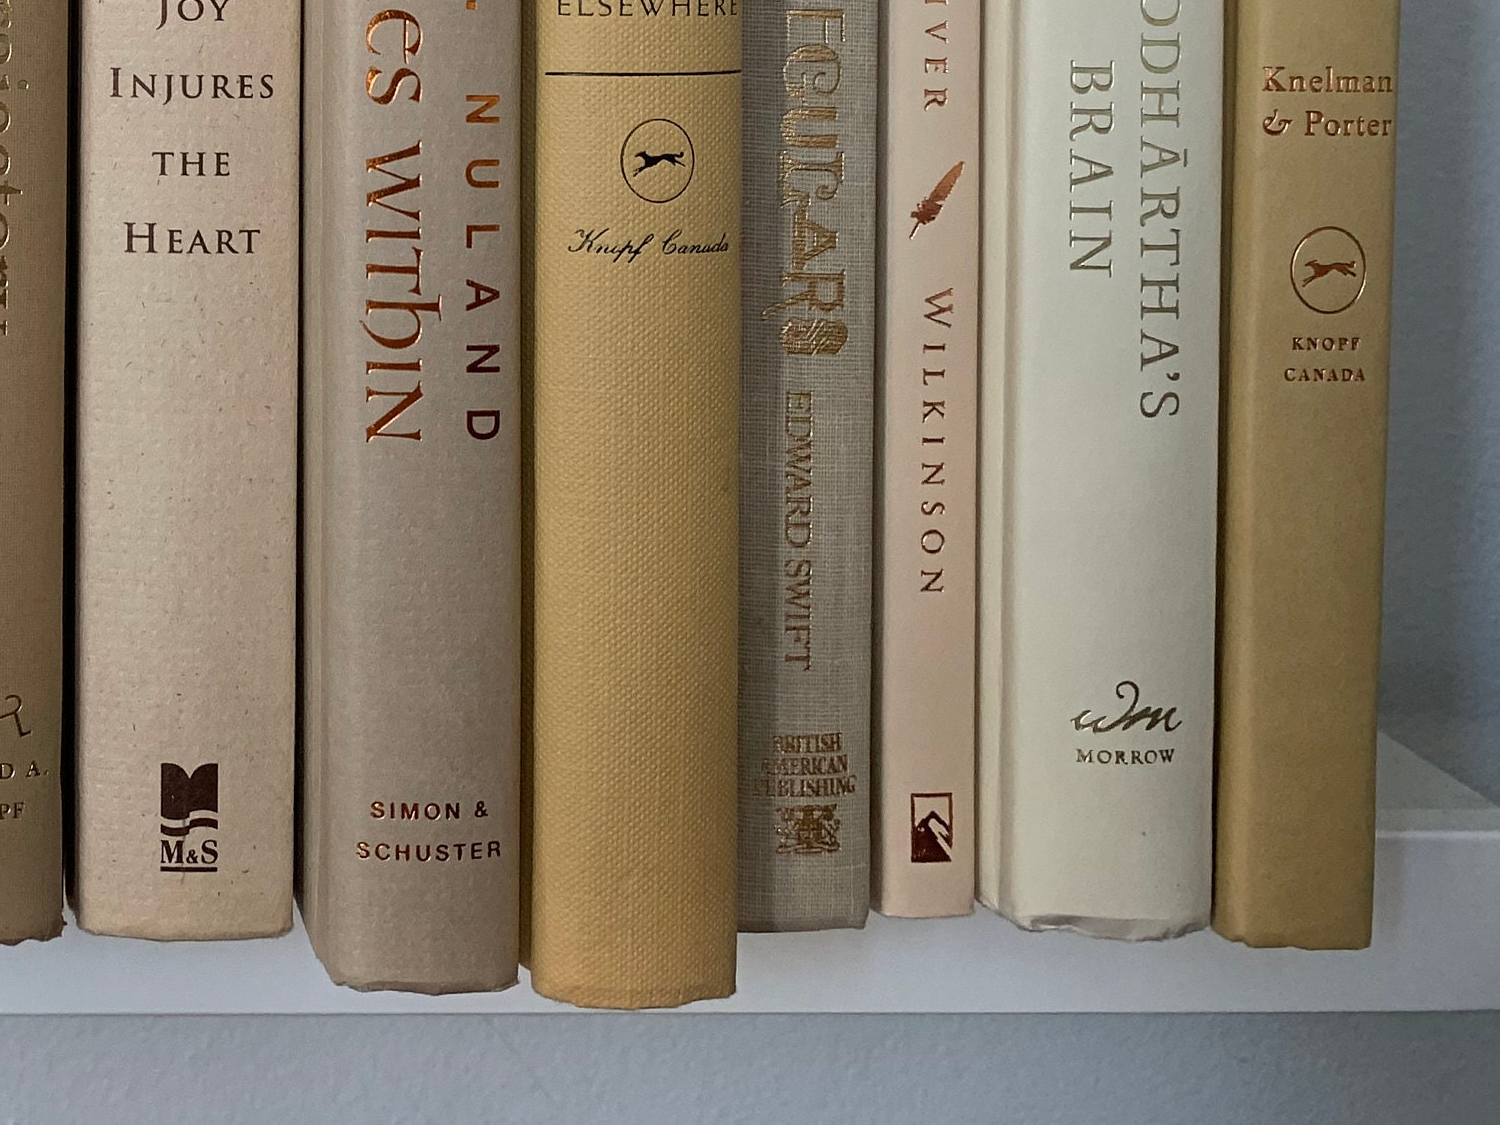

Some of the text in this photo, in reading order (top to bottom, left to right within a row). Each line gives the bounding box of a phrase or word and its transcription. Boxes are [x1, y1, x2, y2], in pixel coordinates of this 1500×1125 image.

[109, 67, 275, 106] INJURES
[1261, 66, 1393, 95] Knelman
[1261, 110, 1393, 138] & Porter
[151, 150, 231, 177] THE
[1069, 60, 1117, 278] BRAIN
[123, 222, 261, 256] HEART
[567, 227, 729, 261] Knopf Canada
[464, 94, 501, 441] NULAND
[1292, 336, 1361, 353] KNOPF
[1284, 367, 1366, 384] CANADA
[919, 287, 954, 595] WILKINSON
[784, 390, 815, 670] EDWARD SWIFT
[1075, 747, 1176, 765] MORROW
[370, 801, 488, 820] SIMON &
[356, 840, 502, 861] SCHUSTER
